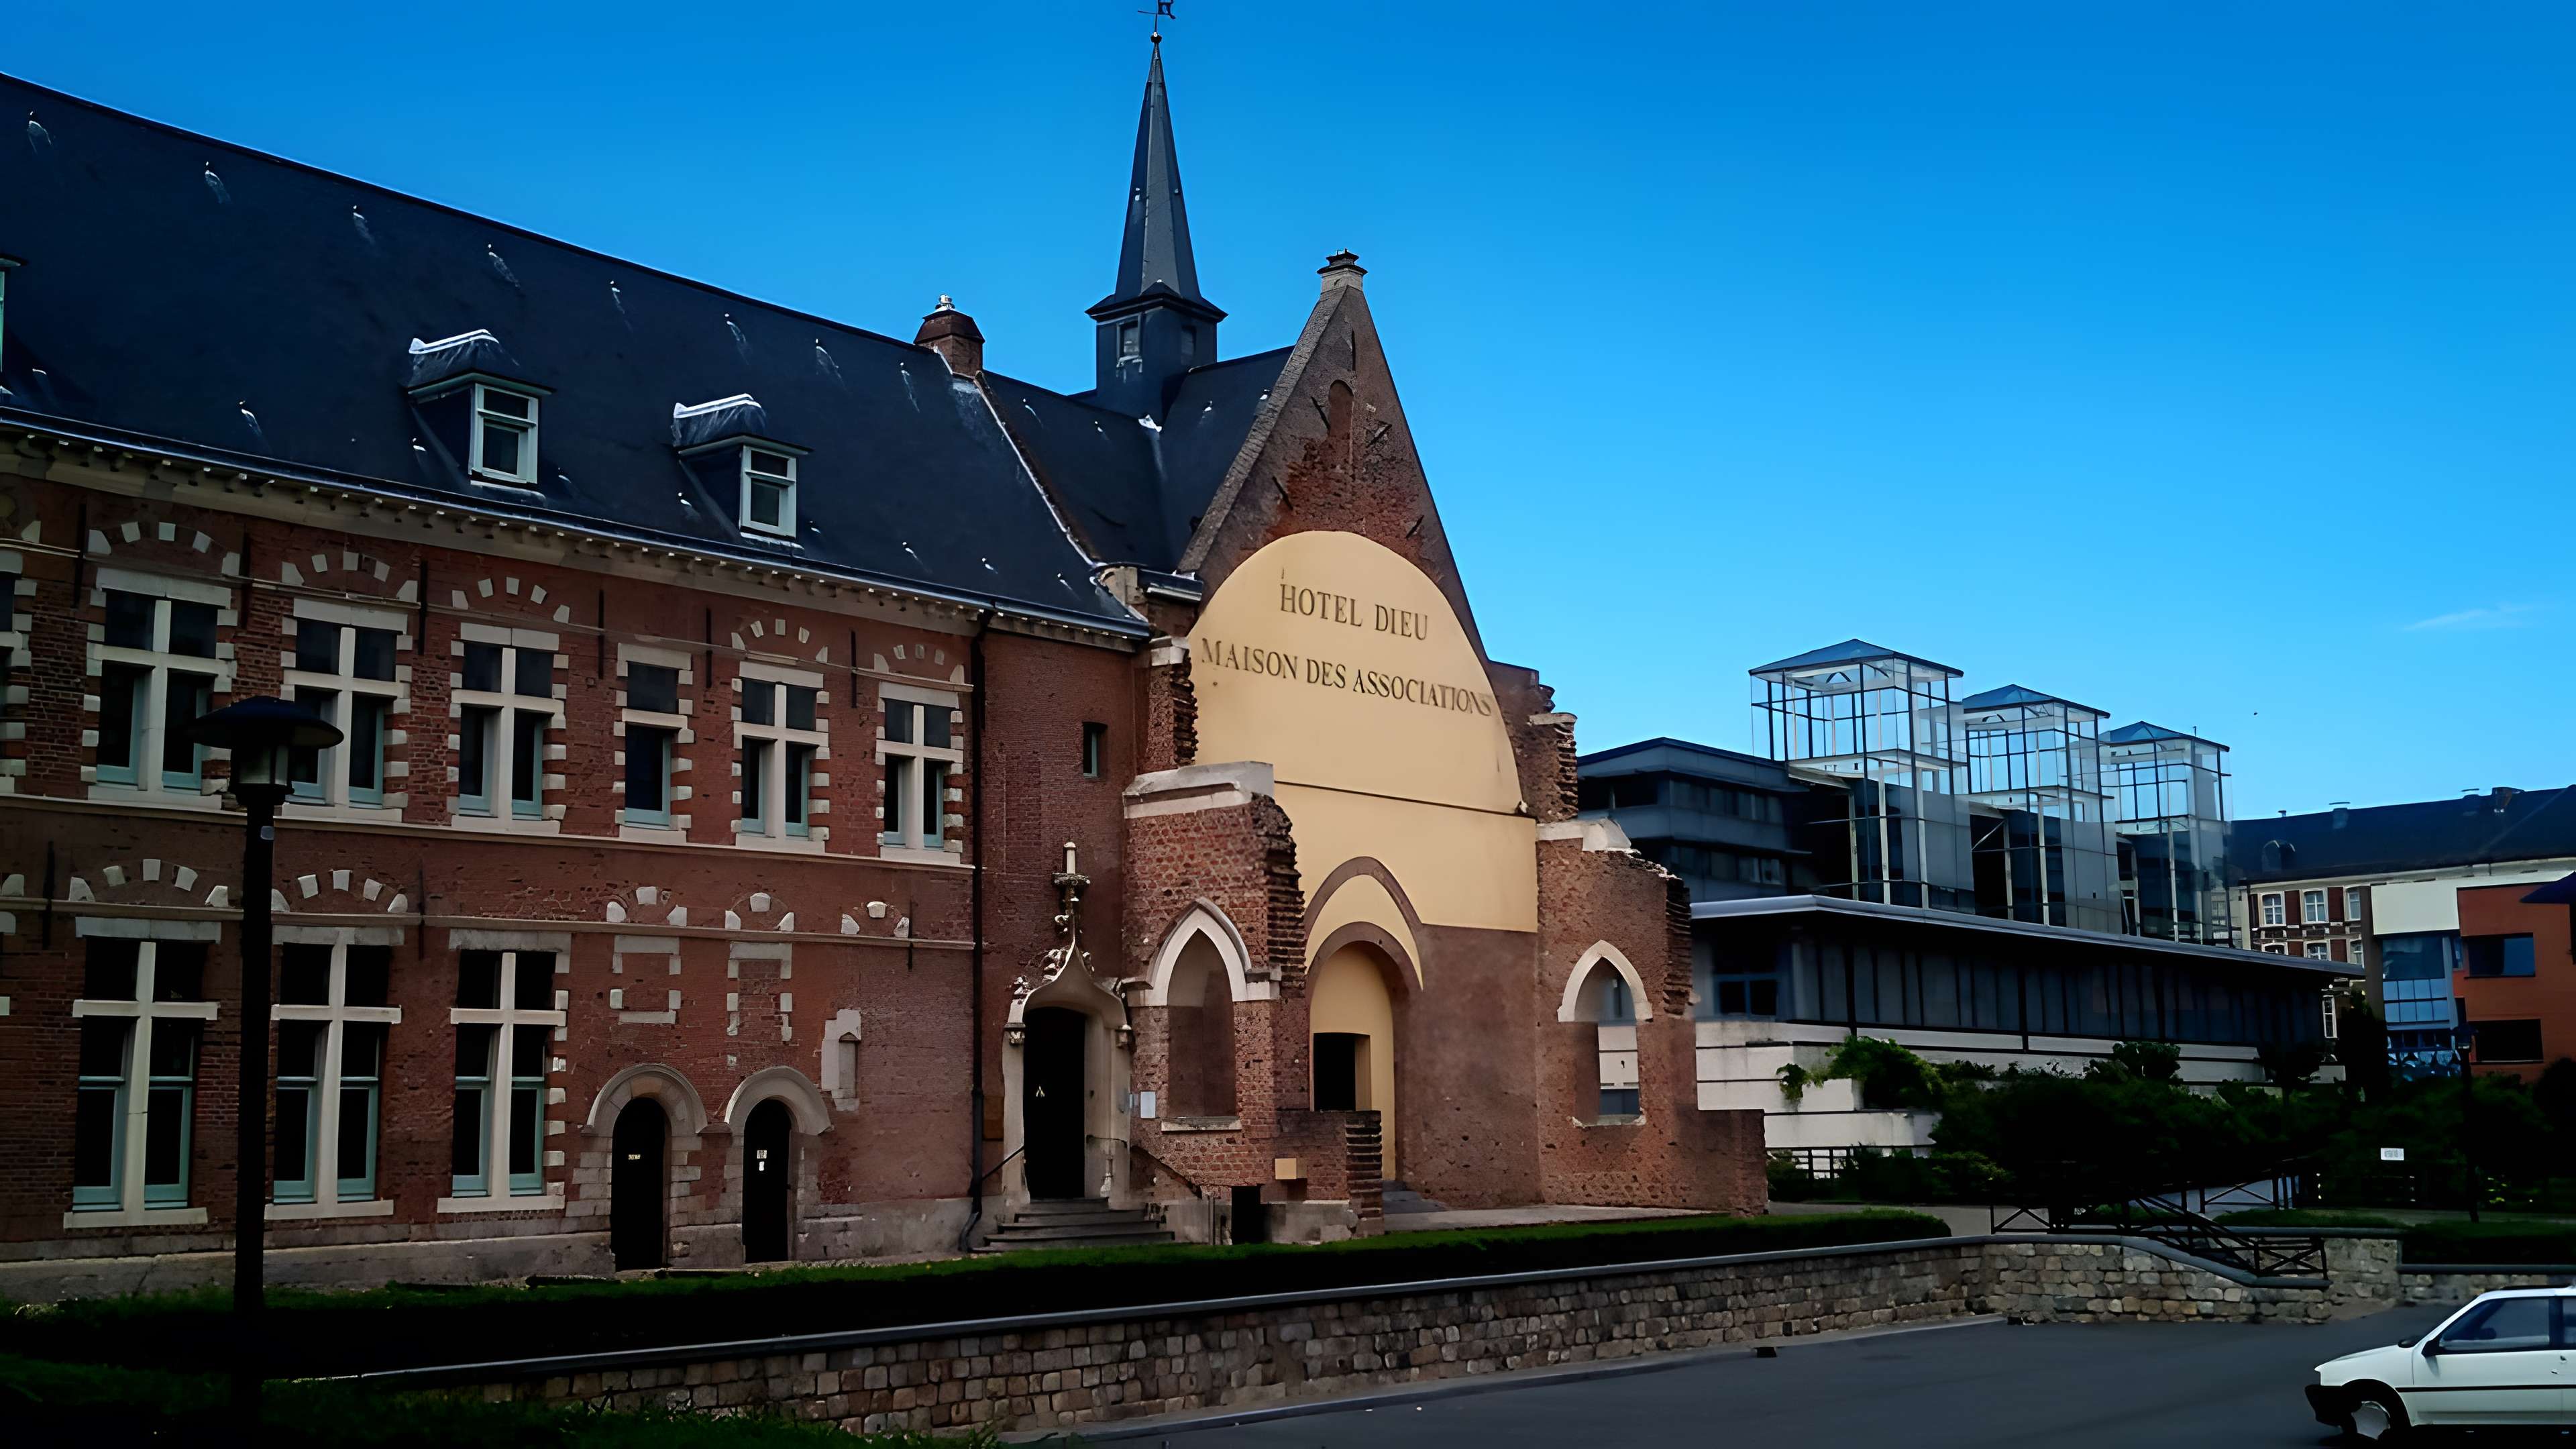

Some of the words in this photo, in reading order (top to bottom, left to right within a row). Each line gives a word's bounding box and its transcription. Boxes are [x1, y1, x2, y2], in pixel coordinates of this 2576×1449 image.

[1280, 583, 1363, 627] HOTEL
[1375, 604, 1428, 641] DIEU
[1201, 638, 1297, 680] MAISON
[1307, 658, 1346, 688] DES
[1353, 669, 1492, 716] ASSOCIATIONS
